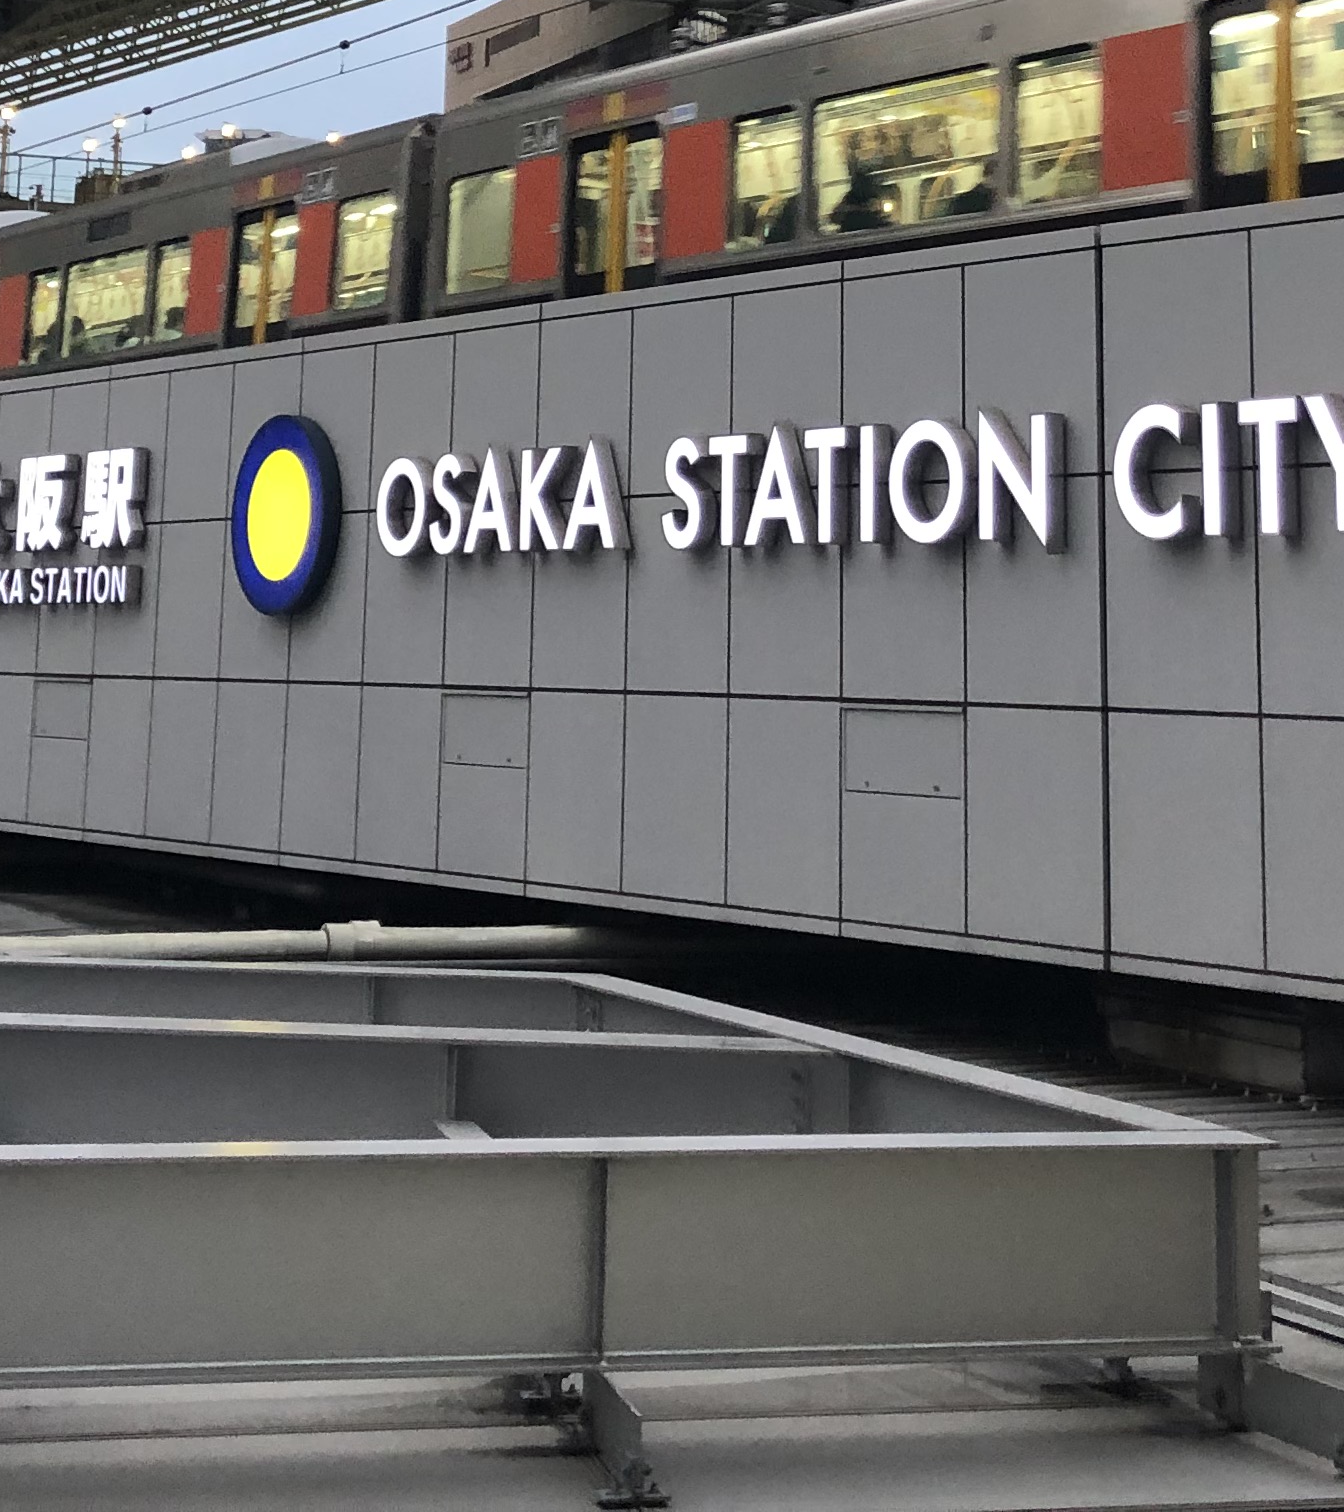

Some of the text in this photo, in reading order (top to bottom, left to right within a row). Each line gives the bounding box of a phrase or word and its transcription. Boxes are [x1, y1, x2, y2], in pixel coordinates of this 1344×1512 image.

[376, 440, 615, 557] OSAKA
[661, 411, 1047, 549] STATION
[30, 565, 127, 604] STATION
